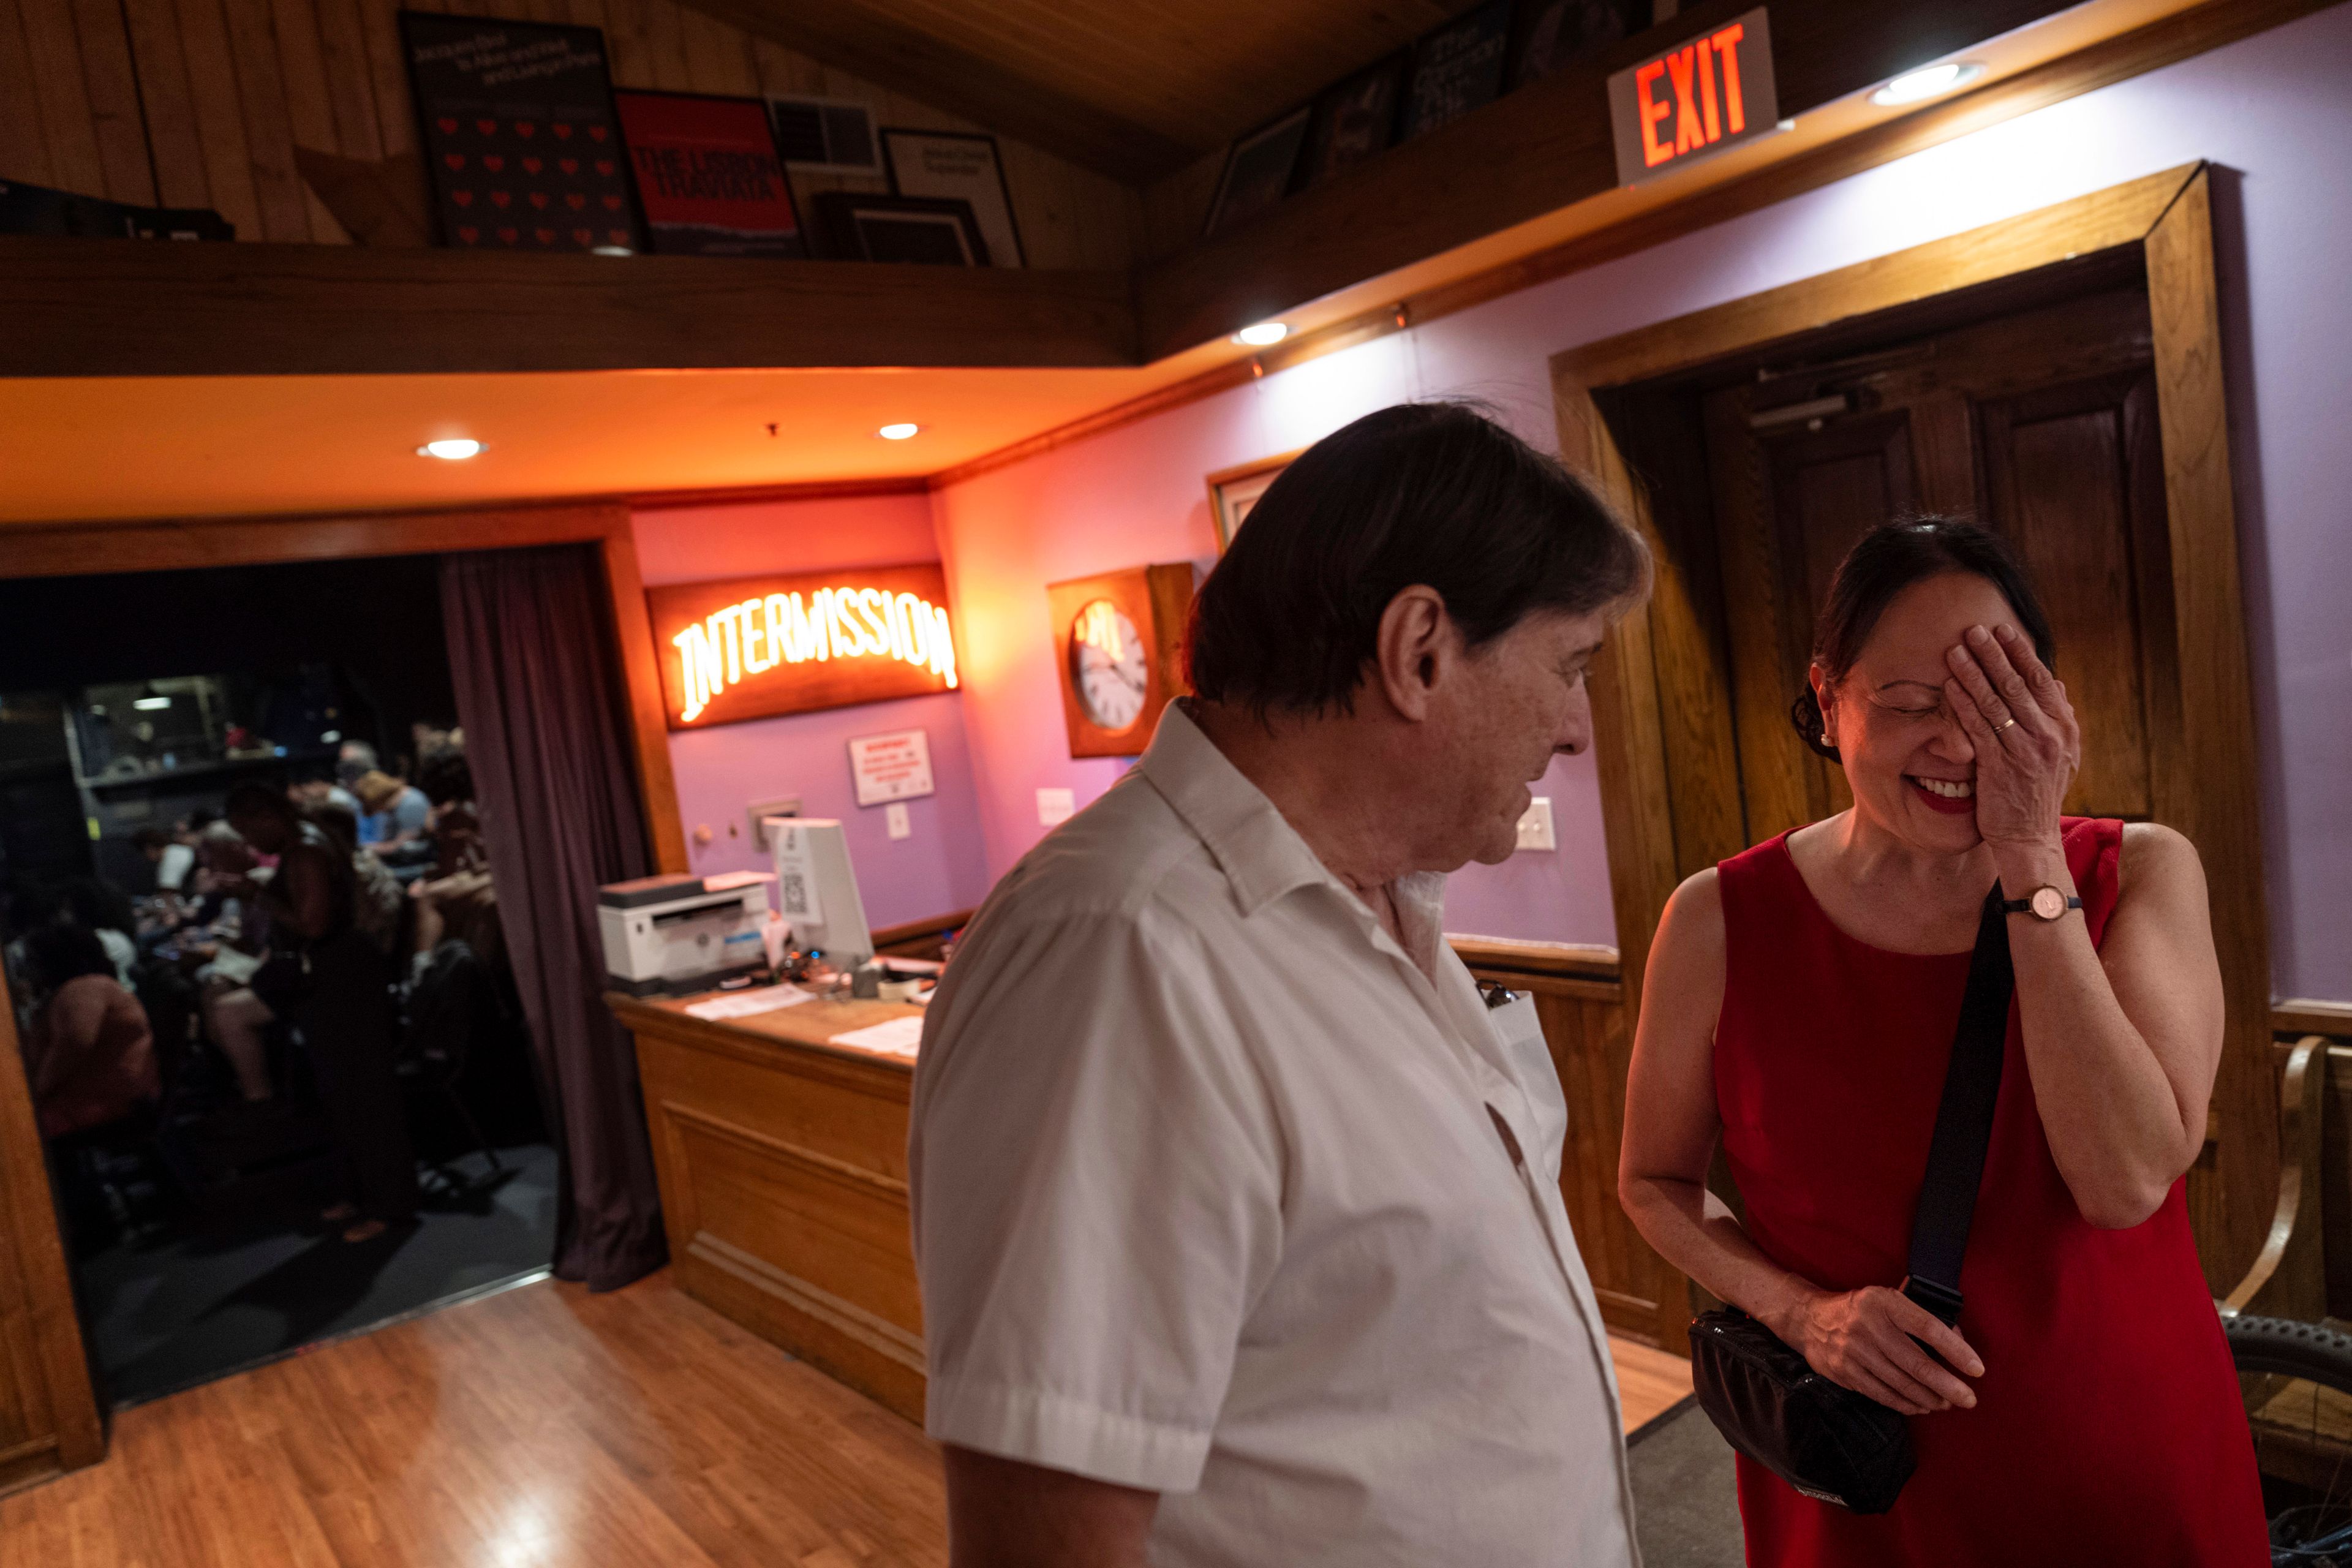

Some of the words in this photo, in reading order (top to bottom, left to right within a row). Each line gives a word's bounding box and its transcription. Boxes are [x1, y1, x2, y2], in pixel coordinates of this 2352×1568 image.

[1635, 23, 1746, 167] EXIT
[636, 146, 685, 172] THE
[653, 172, 775, 201] TRAVIATA
[672, 586, 958, 722] INTERMISSION
